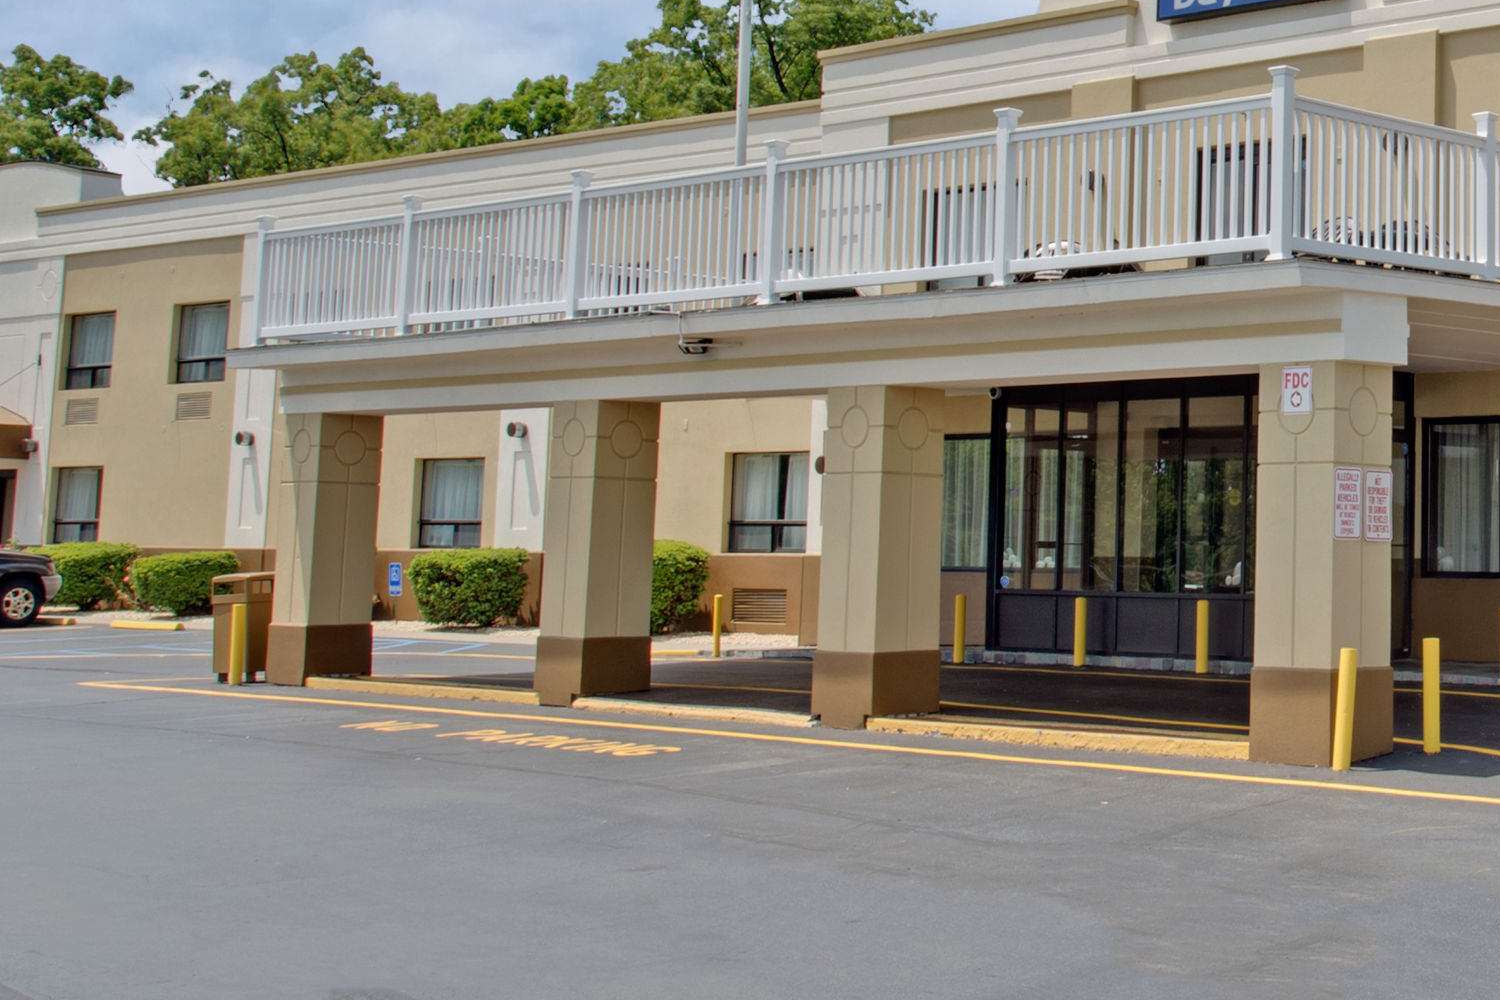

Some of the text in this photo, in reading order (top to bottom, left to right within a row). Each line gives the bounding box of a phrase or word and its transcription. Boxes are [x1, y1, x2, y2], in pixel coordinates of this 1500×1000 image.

[1284, 371, 1309, 389] FDC
[339, 720, 682, 757] NO PARKING
